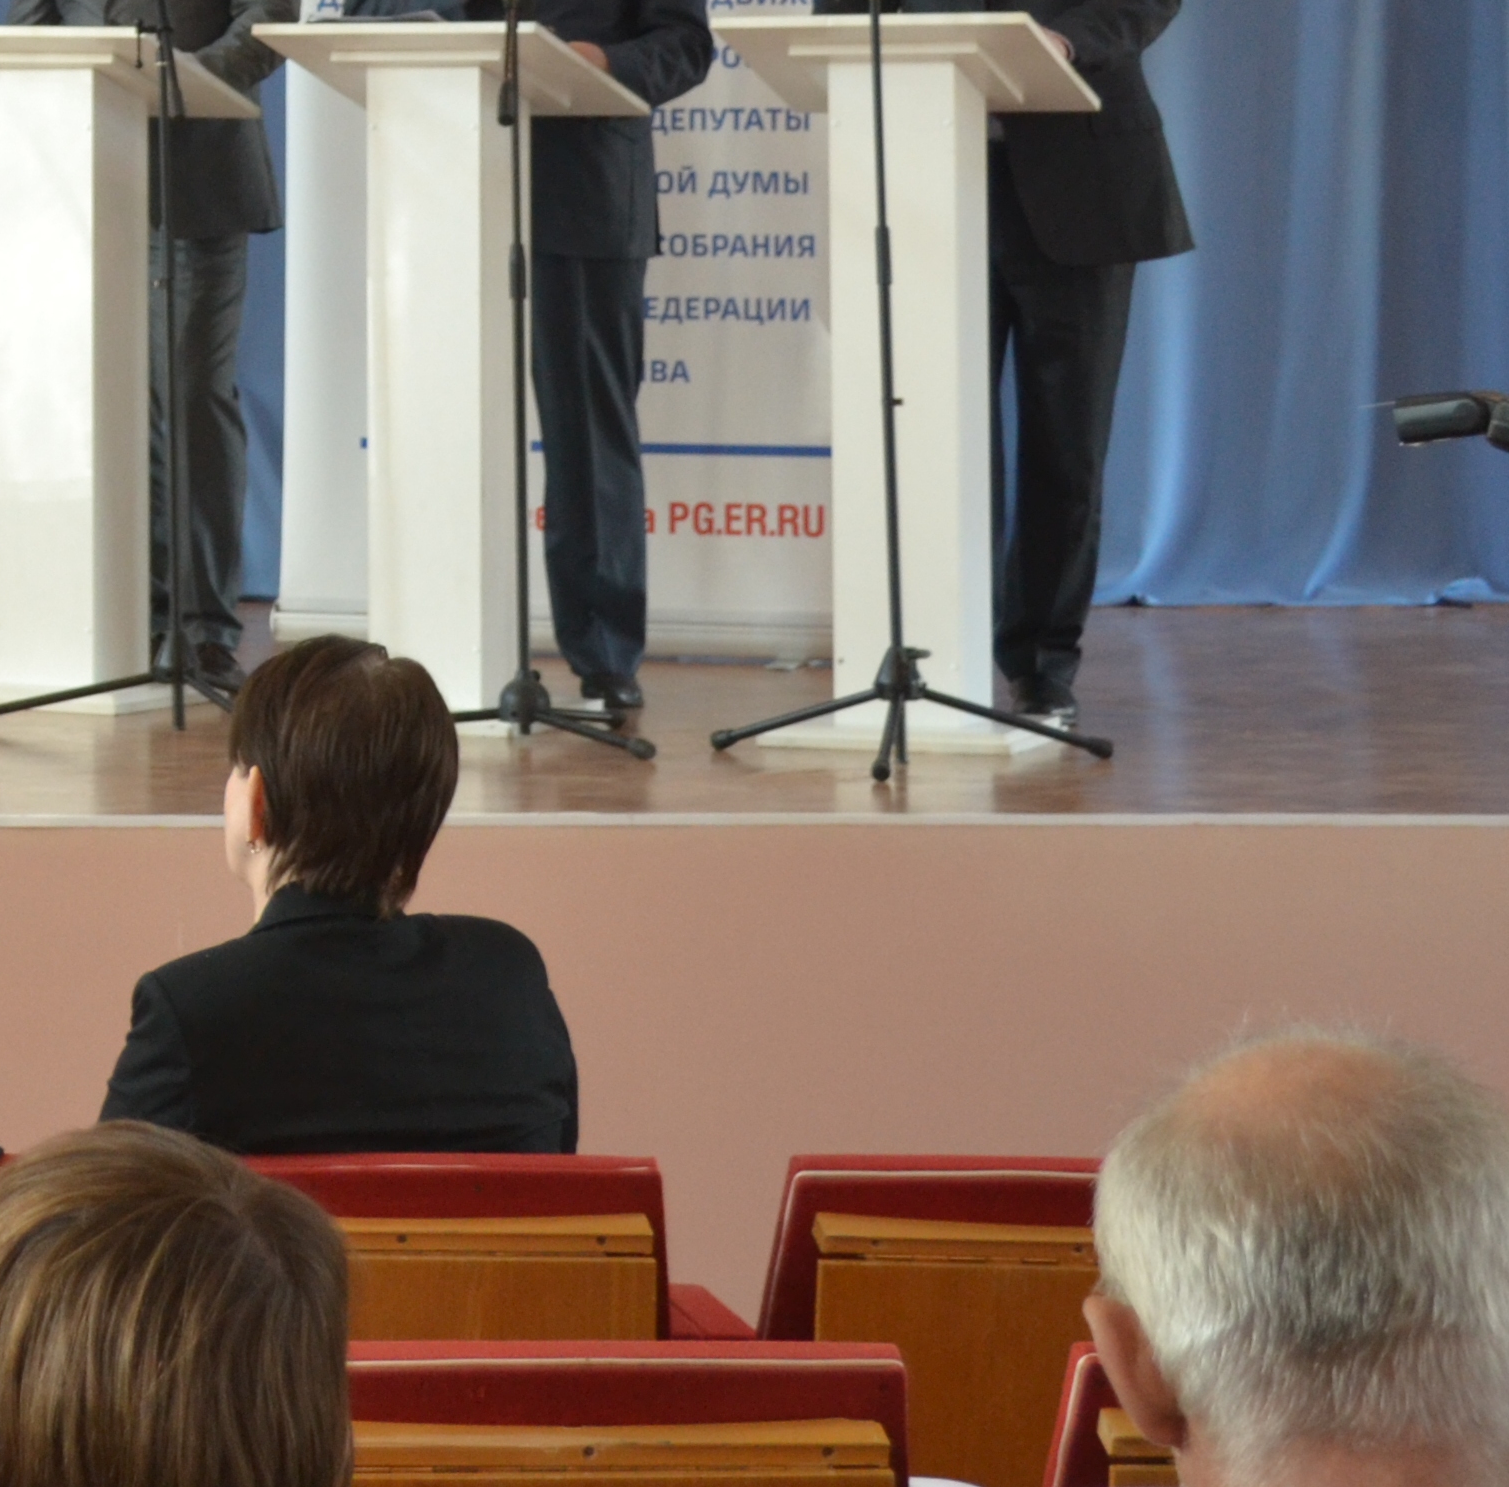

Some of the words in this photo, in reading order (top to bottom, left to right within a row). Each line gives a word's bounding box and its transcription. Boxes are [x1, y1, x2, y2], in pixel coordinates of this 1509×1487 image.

[650, 107, 811, 136] ДЕПУТАТЫ
[707, 170, 809, 199] ДУМЫ
[643, 296, 811, 325] ЕДЕРАЦИИ
[668, 501, 826, 538] PG.ER.RU
